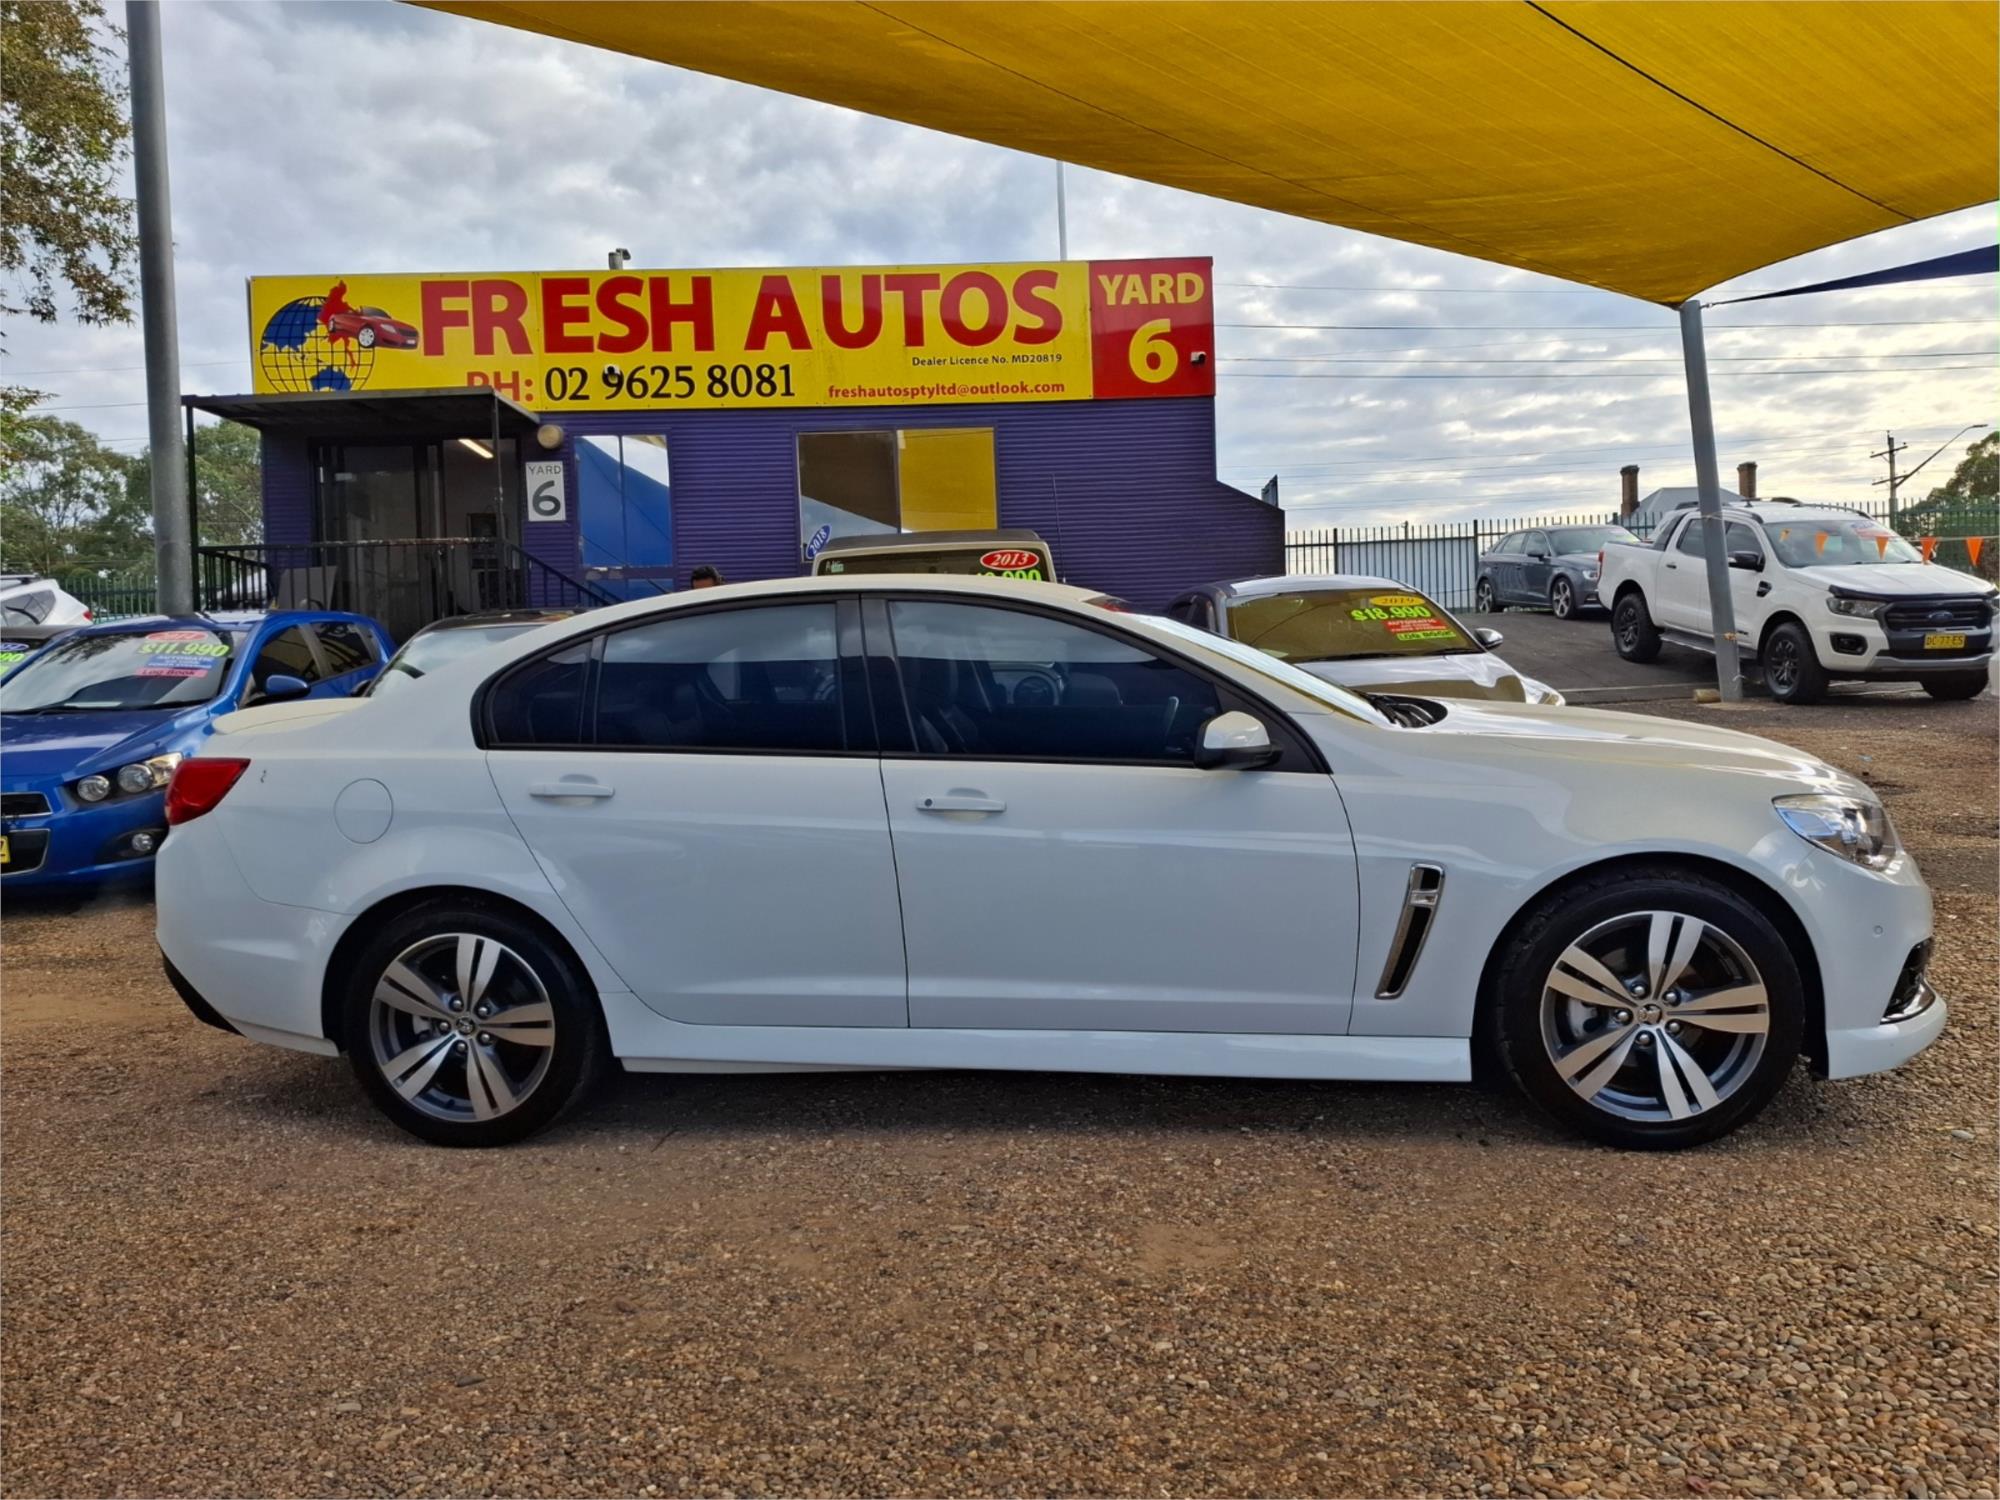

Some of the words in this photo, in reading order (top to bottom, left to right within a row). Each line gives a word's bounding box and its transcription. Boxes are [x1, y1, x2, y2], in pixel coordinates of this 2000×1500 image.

[1097, 272, 1205, 306] YARD
[420, 275, 716, 357] FRESH
[743, 269, 1064, 352] AUTOS
[911, 356, 946, 366] Dealer
[950, 355, 989, 366] Licence
[992, 355, 1009, 364] No.
[1012, 353, 1063, 364] MD20819
[1127, 317, 1178, 384] 6
[466, 370, 534, 402] PH:
[544, 366, 590, 401] 02
[602, 364, 696, 399] 9625
[706, 363, 796, 398] 8081
[827, 381, 1066, 400] freshautosptyltd@outlook.com
[528, 465, 561, 475] YARD
[532, 480, 562, 517] 6
[809, 527, 828, 555] 2018
[989, 553, 1030, 566] 2013
